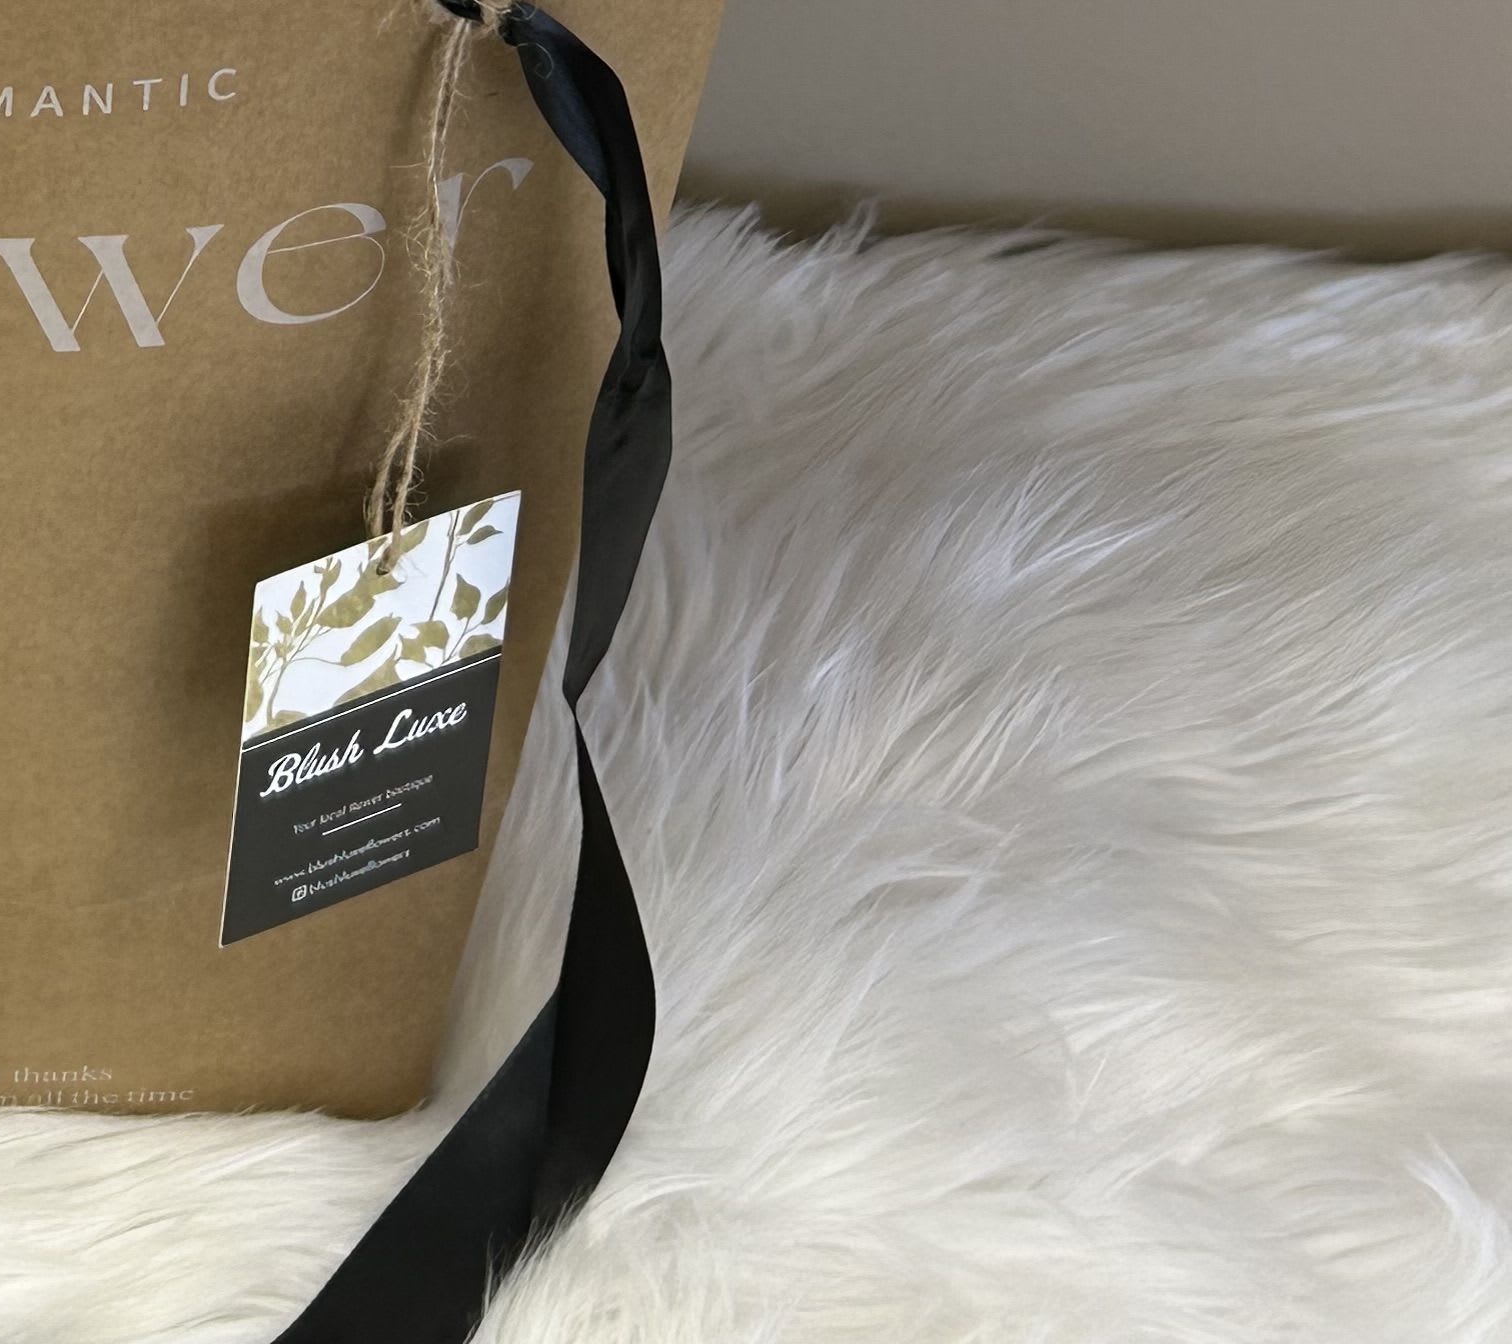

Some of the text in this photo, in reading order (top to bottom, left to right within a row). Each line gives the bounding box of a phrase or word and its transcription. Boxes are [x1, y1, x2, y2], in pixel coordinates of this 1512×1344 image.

[259, 701, 468, 798] Blush Luxe
[72, 1088, 119, 1105] the
[127, 1087, 194, 1103] time
